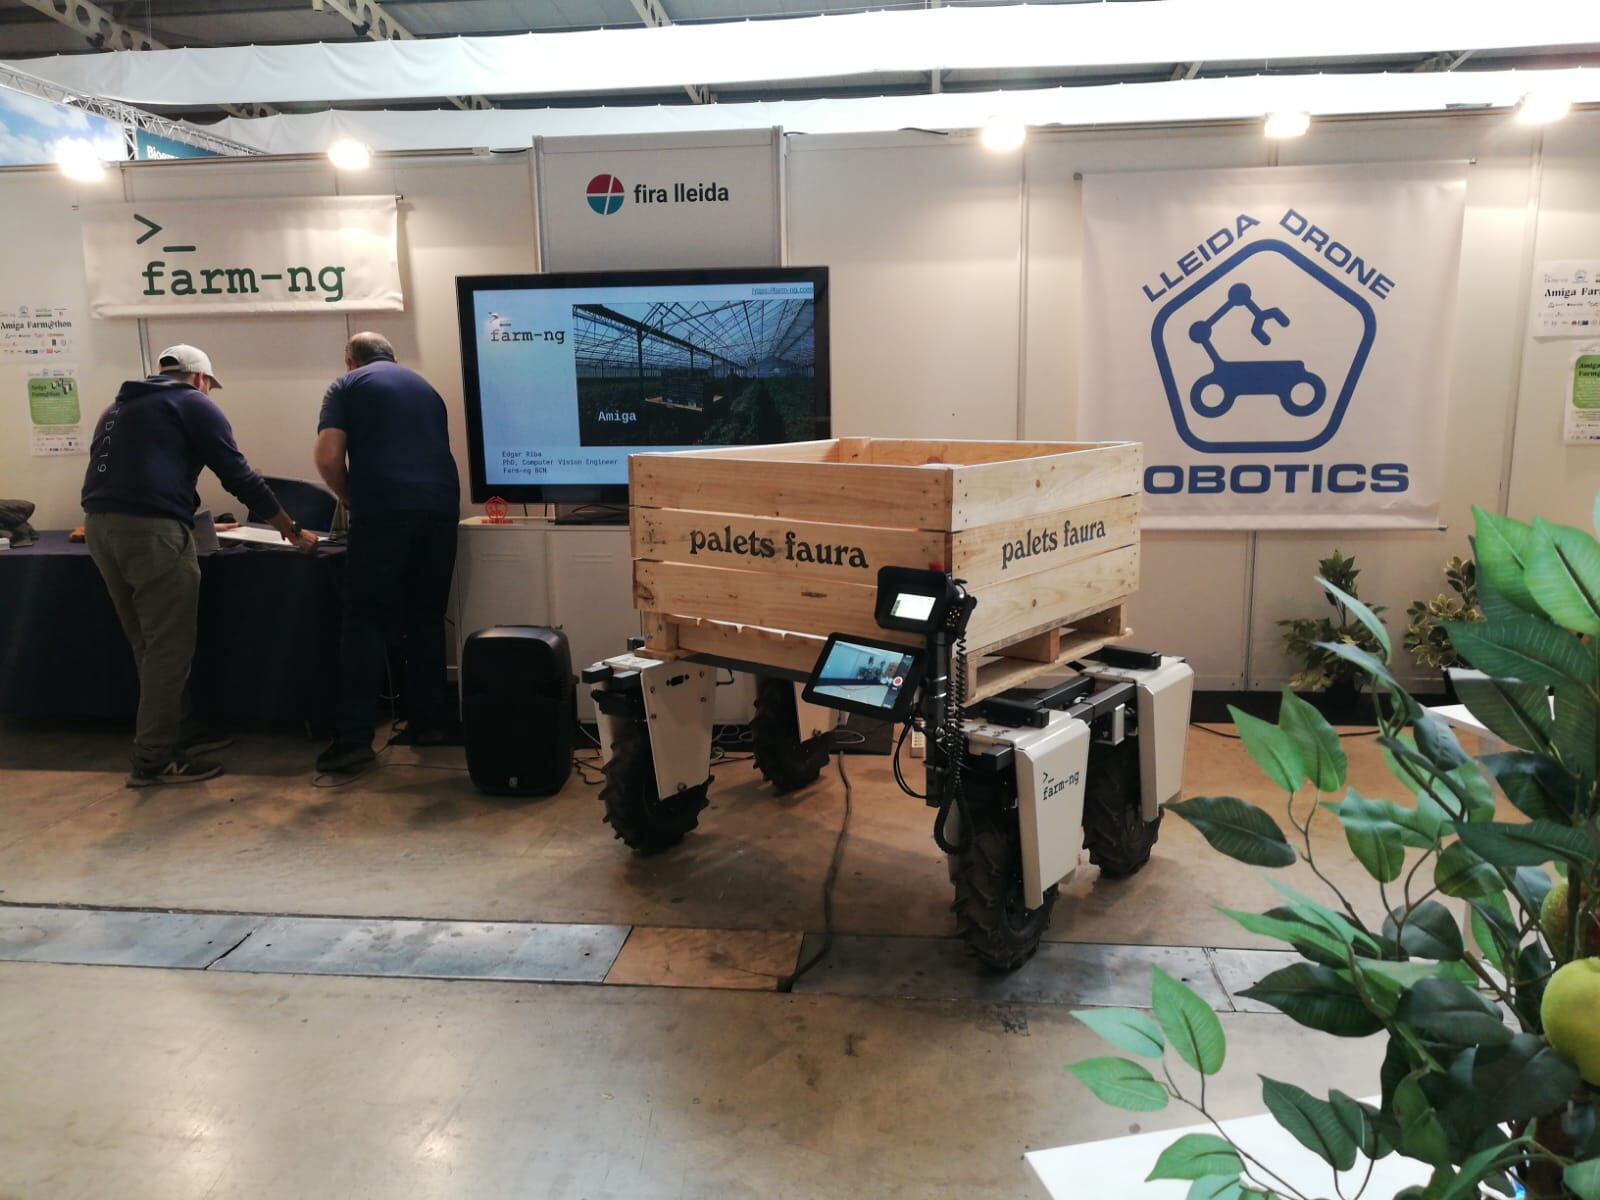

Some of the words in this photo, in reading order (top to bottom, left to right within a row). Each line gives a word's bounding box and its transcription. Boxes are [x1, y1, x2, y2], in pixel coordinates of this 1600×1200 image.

[634, 183, 668, 203] fira
[674, 182, 729, 203] lleida
[1142, 213, 1261, 303] LLEIDA
[1279, 208, 1396, 300] DRONE
[142, 261, 345, 302] farm-ng
[1545, 287, 1577, 299] Amiga
[0, 321, 24, 331] Amiga
[491, 328, 565, 345] farm-ng
[598, 410, 637, 424] Amiga
[502, 450, 522, 459] Edgar
[526, 450, 542, 458] Riba
[522, 458, 554, 467] Computer
[558, 458, 582, 466] Vision
[586, 458, 618, 467] Engineer
[1143, 463, 1409, 494] OBOTICS
[690, 525, 775, 558] palets
[784, 530, 869, 569] faura
[1001, 528, 1058, 570] palets
[1063, 520, 1107, 547] faura
[1043, 771, 1080, 801] farm-ng
